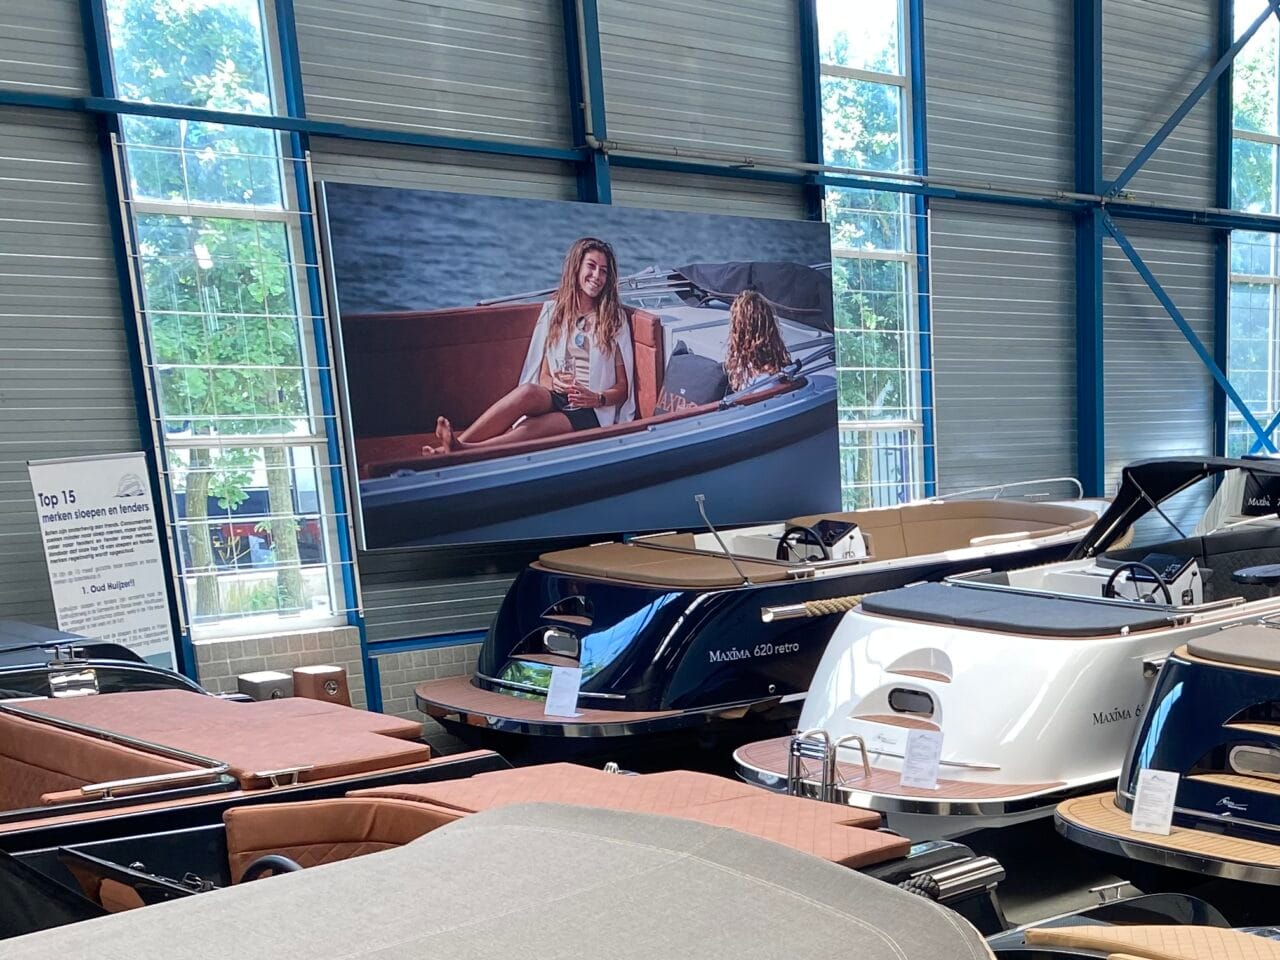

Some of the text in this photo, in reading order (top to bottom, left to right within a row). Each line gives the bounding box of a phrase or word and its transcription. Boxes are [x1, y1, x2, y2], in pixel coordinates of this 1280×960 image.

[38, 490, 76, 508] Top 15
[42, 503, 150, 523] merken sloepen en tenders
[90, 583, 106, 593] Oud
[754, 643, 774, 657] 620
[774, 642, 799, 654] retro
